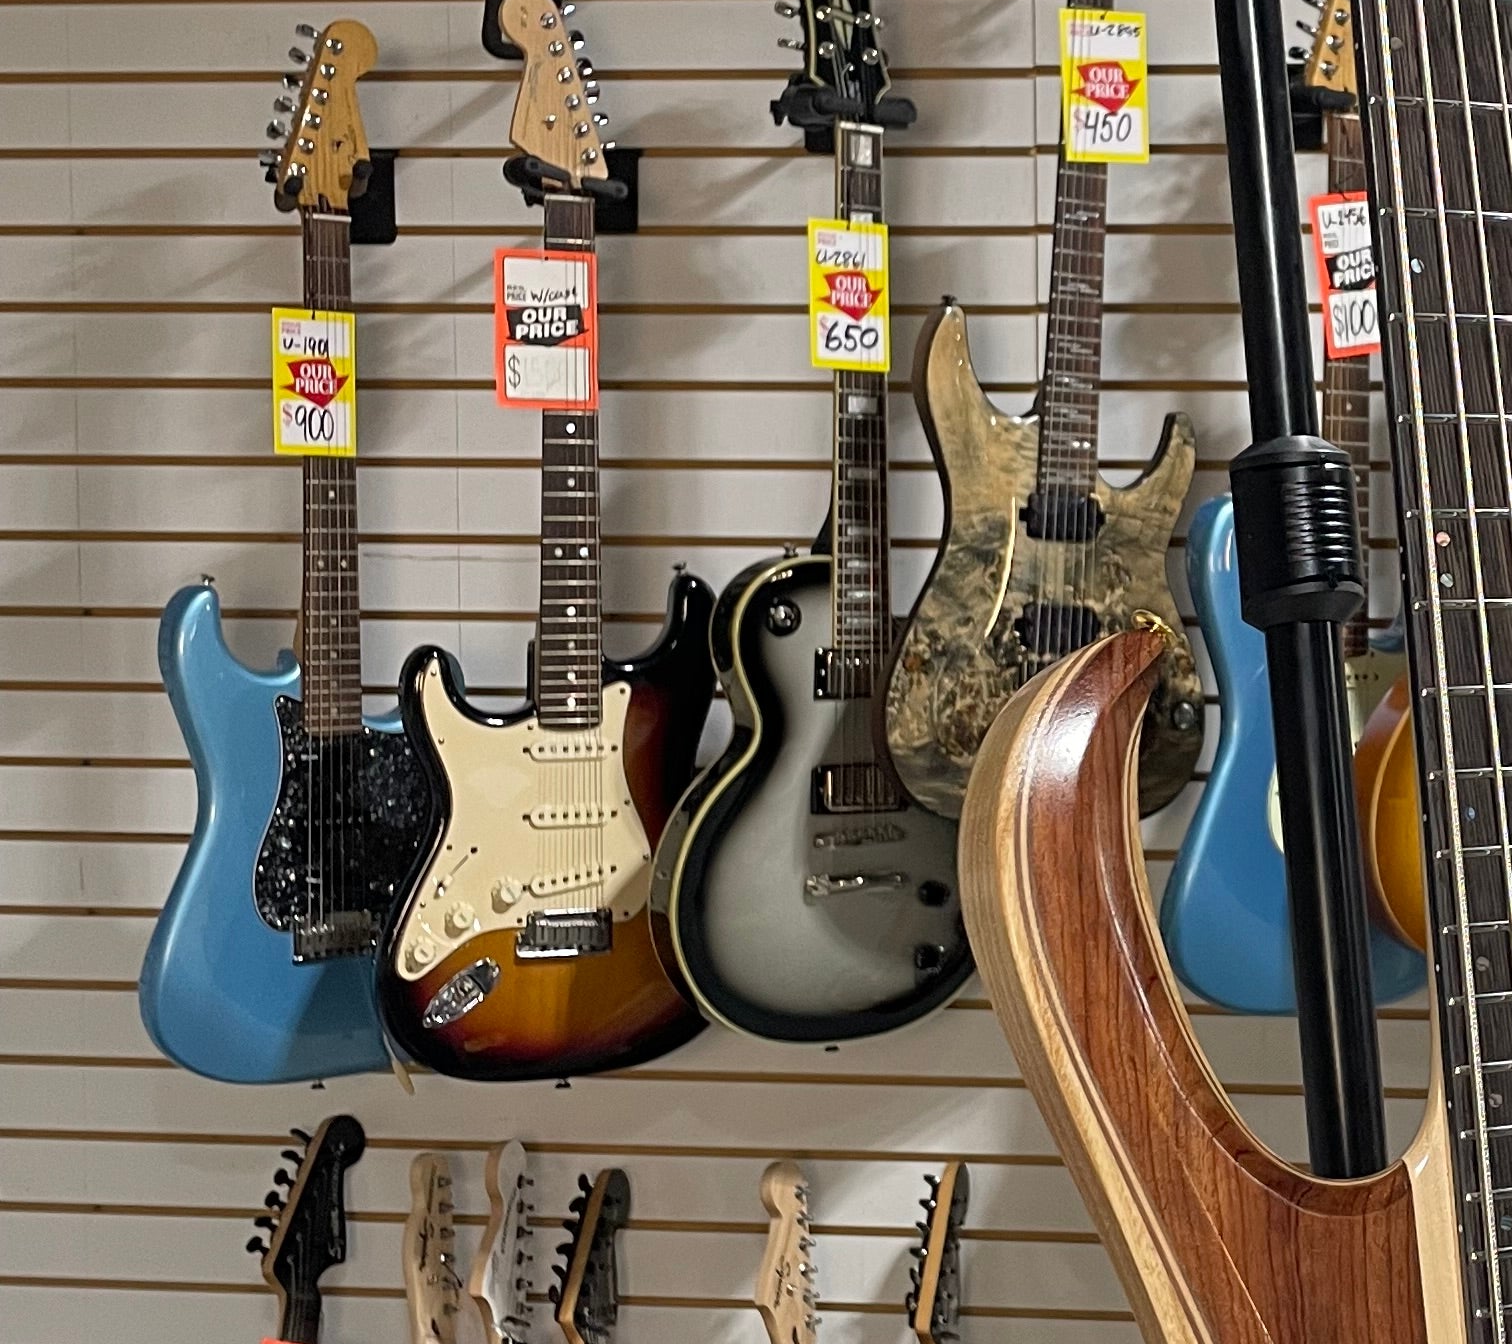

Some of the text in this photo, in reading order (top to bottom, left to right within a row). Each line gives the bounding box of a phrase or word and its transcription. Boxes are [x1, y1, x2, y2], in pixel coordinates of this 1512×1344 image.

[1089, 67, 1124, 83] OUR
[1085, 81, 1130, 99] PRICE
[1336, 249, 1372, 271] OUR
[835, 275, 868, 291] OUR
[1332, 264, 1375, 289] PRIC
[831, 290, 873, 307] PRICE
[521, 306, 567, 324] OUR
[515, 319, 579, 341] PRICE
[299, 363, 333, 378] OUR
[295, 377, 337, 395] PRICE
